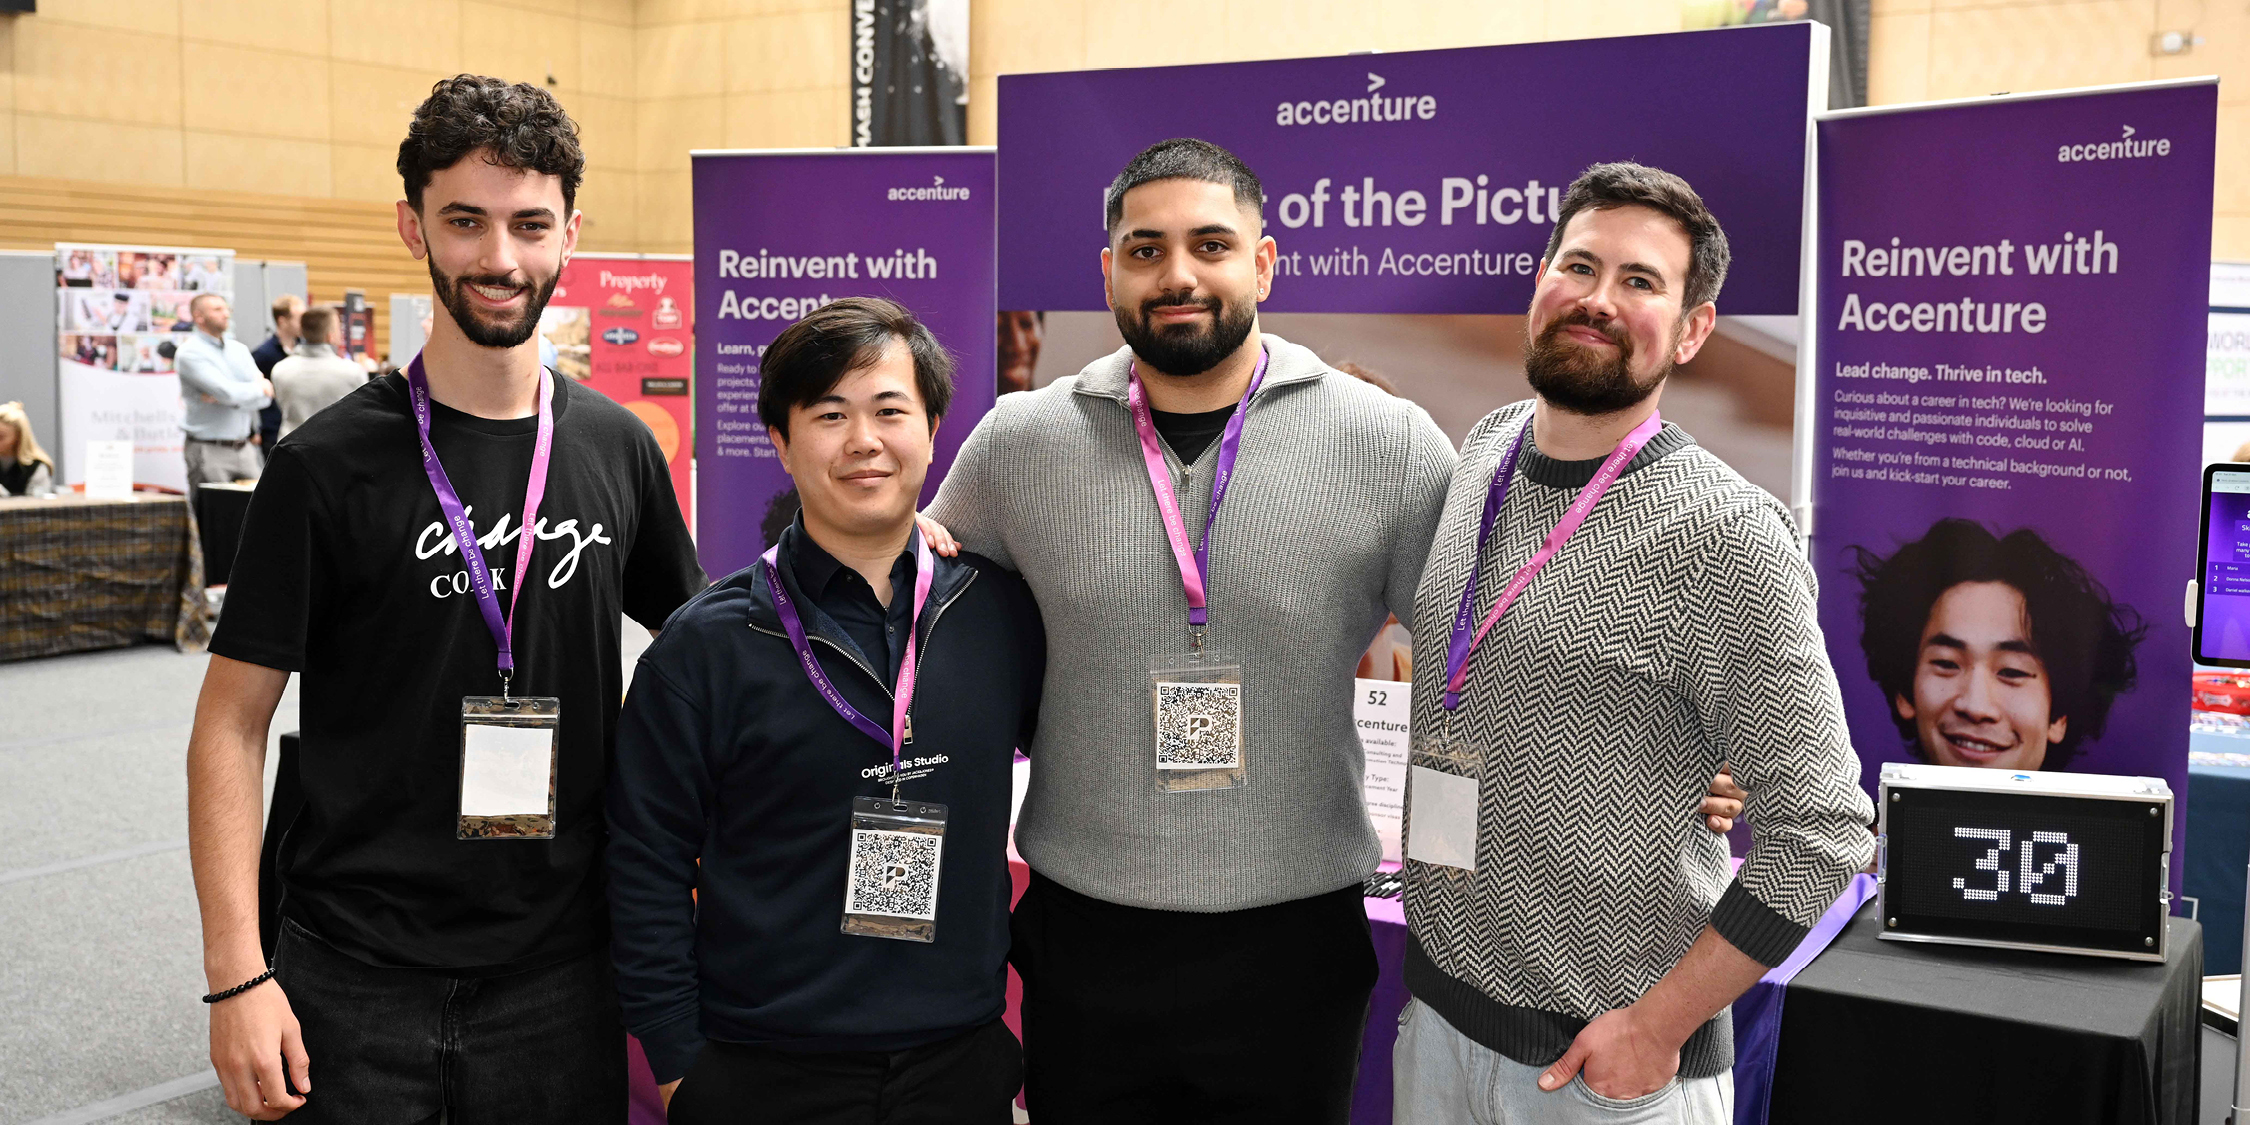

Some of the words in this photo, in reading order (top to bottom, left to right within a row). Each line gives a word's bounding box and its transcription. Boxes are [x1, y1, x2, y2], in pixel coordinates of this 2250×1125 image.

[1276, 92, 1436, 126] accenture
[2058, 136, 2171, 163] accenture
[887, 184, 970, 202] accenture
[1279, 178, 1330, 228] of
[1341, 176, 1426, 227] the
[718, 249, 858, 279] Reinvent
[866, 248, 937, 279] with
[1309, 248, 1368, 277] with
[1378, 247, 1533, 276] Accenture
[1841, 237, 2014, 277] Reinvent
[2024, 229, 2119, 275] with
[600, 270, 667, 295] Property
[1838, 293, 2046, 334] Accenture
[717, 343, 755, 356] Learn,
[717, 363, 745, 376] Ready
[747, 364, 757, 374] to
[1835, 362, 1870, 378] Lead
[1871, 363, 1932, 383] change.
[1935, 364, 1983, 382] Thrive
[1986, 365, 2002, 383] in
[2005, 366, 2047, 384] tech.
[717, 378, 756, 388] projects,
[416, 386, 425, 412] change
[717, 402, 738, 413] offer
[740, 404, 749, 413] at
[1834, 389, 1875, 404] Curious
[1876, 391, 1909, 405] about
[1911, 396, 1919, 406] a
[1921, 396, 1956, 407] career
[1958, 394, 1969, 408] in
[1971, 395, 2006, 411] tech?
[2009, 397, 2043, 411] We're
[2045, 398, 2092, 417] looking
[2094, 399, 2114, 415] for
[1135, 400, 1147, 427] change
[1834, 407, 1887, 424] inquisitive
[1888, 409, 1910, 423] and
[1912, 411, 1973, 427] passionate
[1975, 413, 2041, 430] individuals
[2044, 417, 2057, 431] to
[2059, 418, 2093, 433] solve
[717, 420, 751, 432] Explore
[539, 426, 550, 457] change
[717, 433, 770, 444] placements
[1624, 439, 1638, 452] Let
[1833, 425, 1886, 440] real-world
[1887, 427, 1947, 445] challenges
[1949, 430, 1974, 445] with
[1975, 433, 2012, 449] code,
[2014, 435, 2050, 450] cloud
[2052, 439, 2066, 451] or
[2068, 437, 2085, 452] AI.
[717, 447, 723, 456] &
[753, 447, 776, 458] Start
[1607, 452, 1627, 473] there
[1494, 475, 1505, 486] Let
[1500, 452, 1513, 473] there
[1832, 447, 1876, 462] Whether
[1878, 449, 1912, 465] you're
[1914, 451, 1941, 467] from
[1942, 457, 1950, 467] a
[1951, 454, 2007, 472] technical
[2010, 458, 2084, 479] background
[2087, 466, 2102, 479] or
[2105, 467, 2132, 483] not,
[1216, 470, 1228, 500] change
[1598, 472, 1612, 484] be
[1831, 464, 1849, 478] join
[1851, 468, 1864, 479] us
[1865, 467, 1887, 481] and
[1889, 468, 1940, 486] kick-start
[1941, 474, 1966, 488] your
[1969, 477, 2012, 490] career.
[1575, 483, 1600, 514] change
[528, 512, 536, 526] Let
[1157, 479, 1167, 492] Let
[1162, 492, 1173, 514] there
[1168, 514, 1177, 526] be
[1173, 527, 1187, 557] change
[454, 515, 472, 547] change
[522, 527, 533, 550] there
[468, 548, 476, 560] be
[471, 560, 485, 584] there
[1523, 562, 1536, 575] Let
[430, 567, 506, 599] COK
[479, 585, 490, 600] Let
[1507, 576, 1525, 597] there
[778, 594, 787, 605] Let
[1498, 597, 1509, 608] be
[1457, 618, 1466, 631] Let
[1462, 593, 1472, 617] there
[802, 650, 820, 678] change
[903, 654, 911, 666] be
[818, 678, 827, 690] be
[900, 667, 911, 698] change
[826, 689, 843, 708] there
[1367, 690, 1387, 706] 52
[843, 707, 856, 720] Let
[1356, 718, 1408, 733] centure
[1365, 738, 1397, 747] available:
[914, 753, 949, 767] Studio
[1371, 774, 1389, 783] Type:
[1953, 827, 2079, 906] 30
